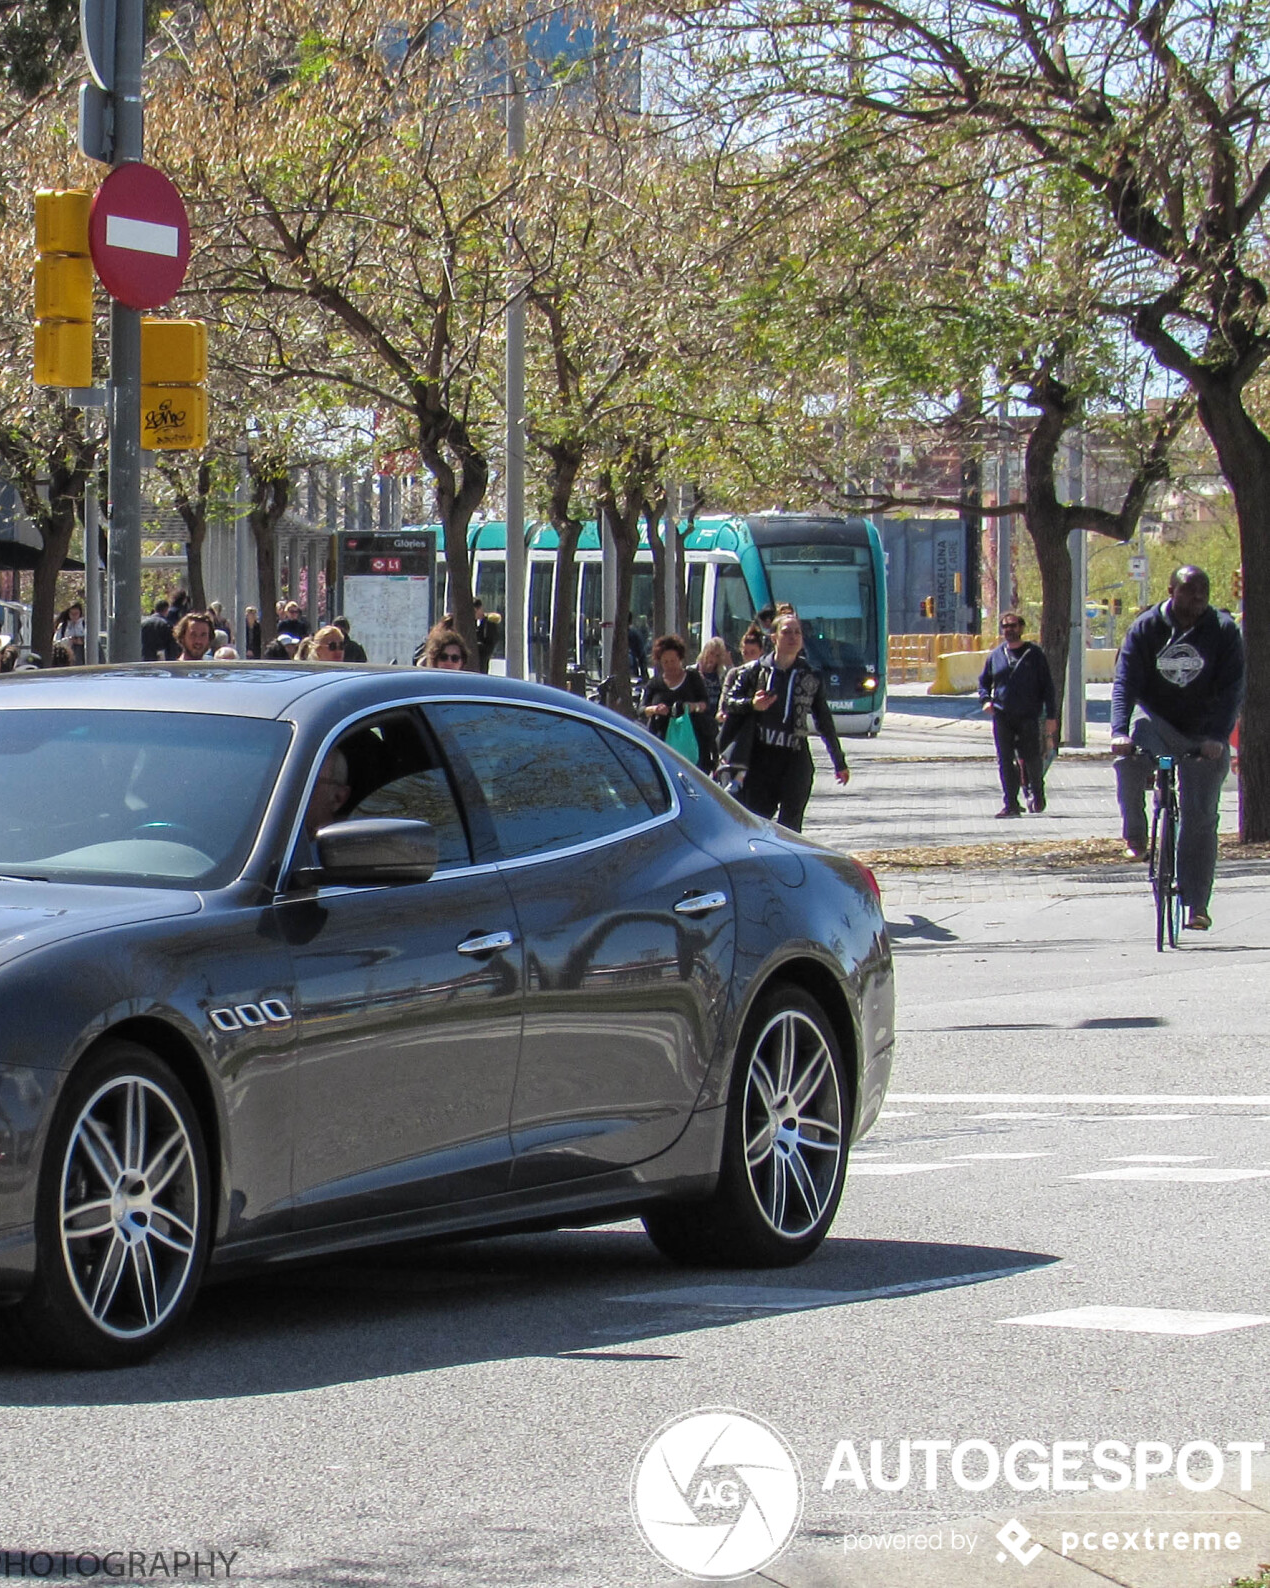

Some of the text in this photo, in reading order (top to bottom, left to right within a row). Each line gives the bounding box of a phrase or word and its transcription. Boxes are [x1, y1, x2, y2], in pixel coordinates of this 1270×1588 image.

[388, 560, 399, 569] L1
[937, 540, 947, 609] BARCELONA
[826, 701, 854, 710] TRAM
